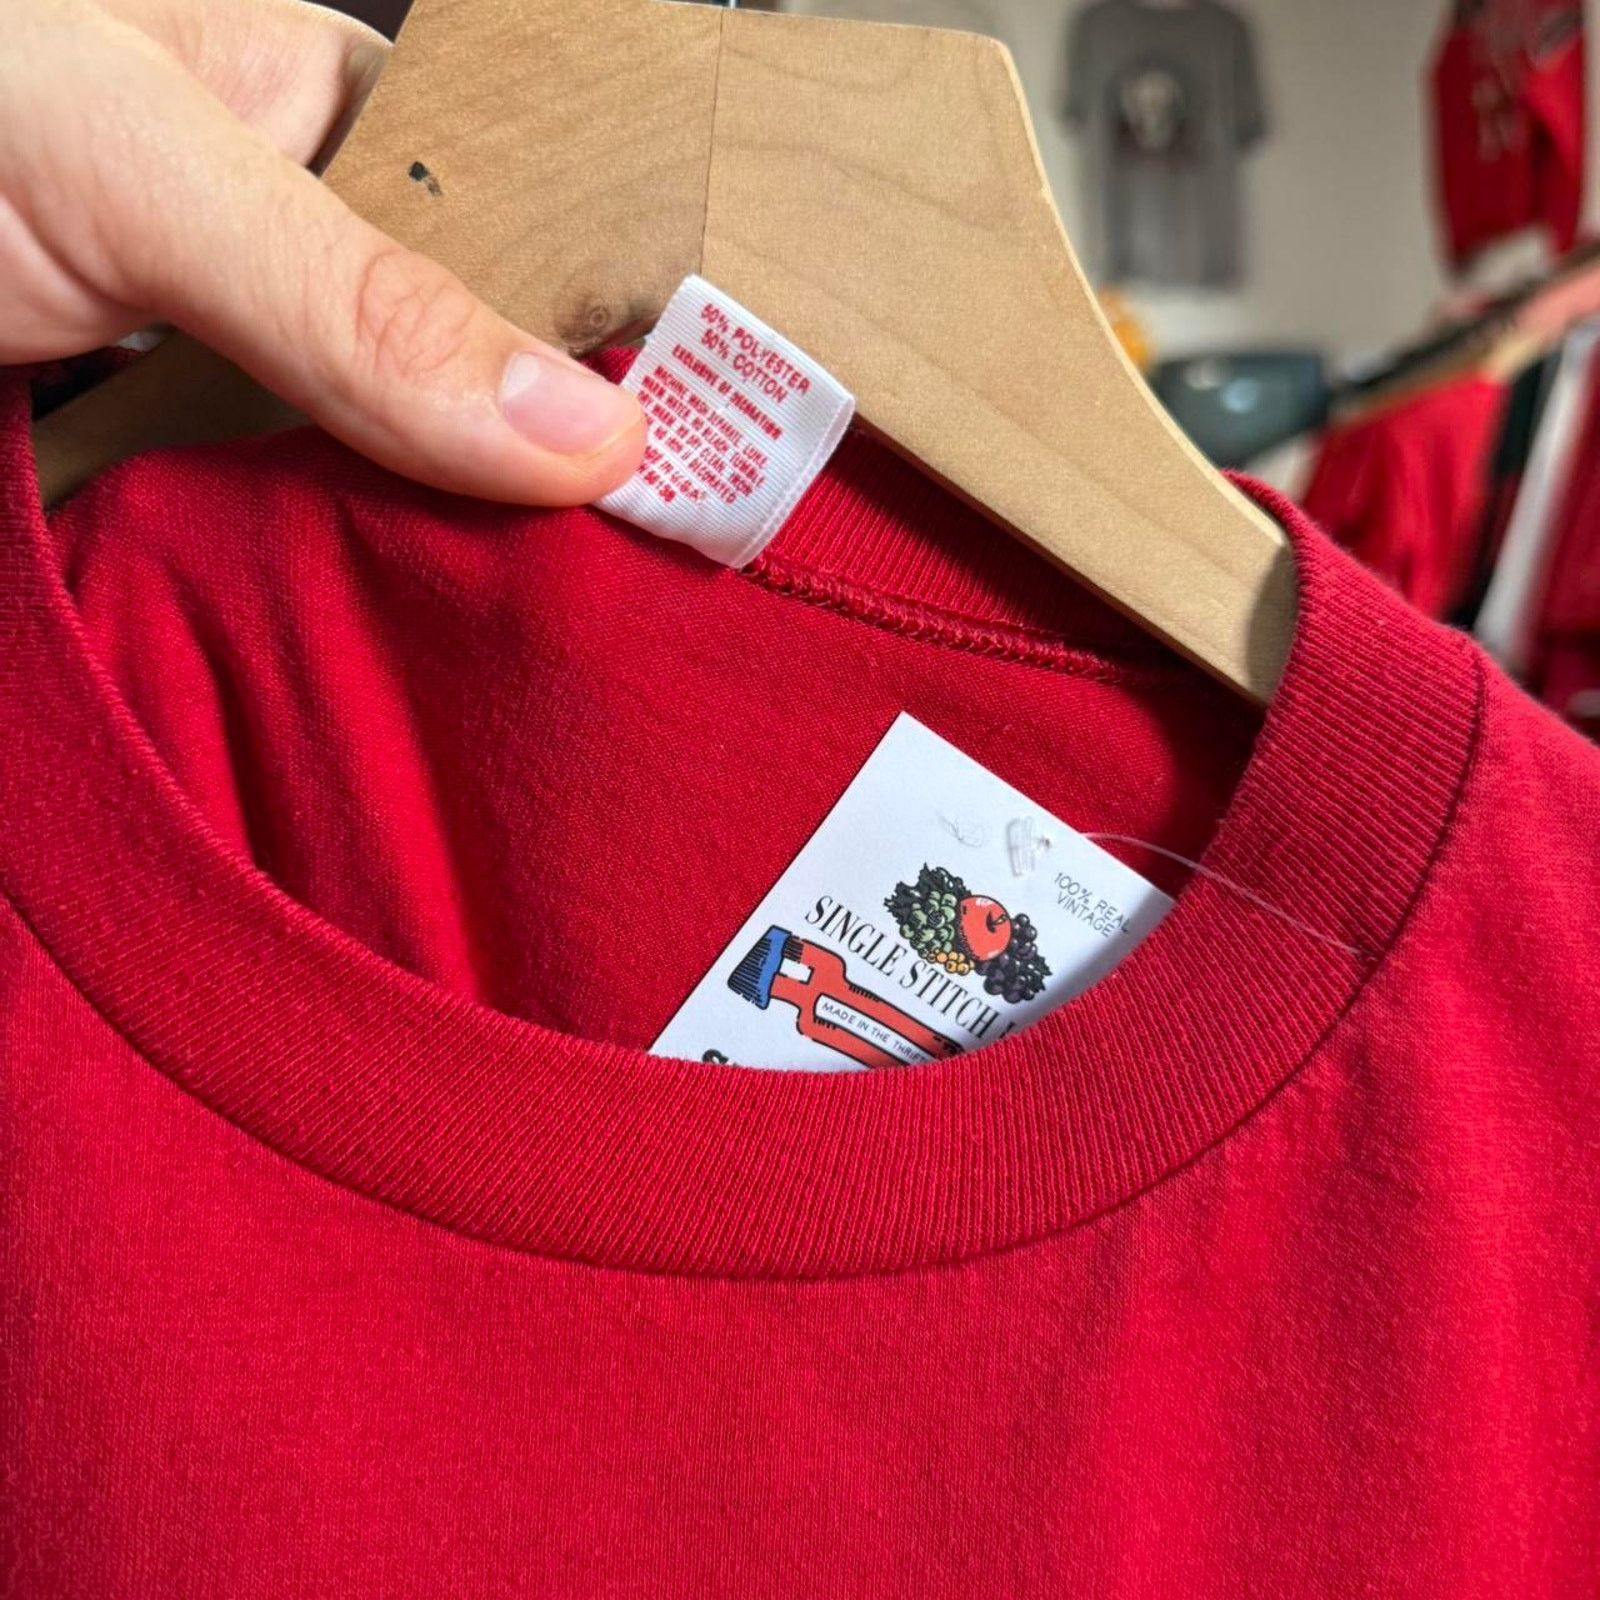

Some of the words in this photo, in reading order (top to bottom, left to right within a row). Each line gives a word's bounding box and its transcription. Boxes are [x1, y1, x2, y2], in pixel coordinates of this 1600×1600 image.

[701, 303, 729, 333] 50%
[733, 327, 811, 395] POLYESTER
[701, 328, 730, 359] 50%
[733, 354, 788, 403] COTTON
[1054, 872, 1093, 904] 100%
[1094, 899, 1130, 933] REAL
[1057, 890, 1115, 938] VINTAGE
[805, 895, 907, 976] SINGLE
[900, 960, 999, 1038] STITCH
[822, 1001, 857, 1025] MADE
[857, 1018, 870, 1032] IN
[871, 1025, 890, 1043] THE
